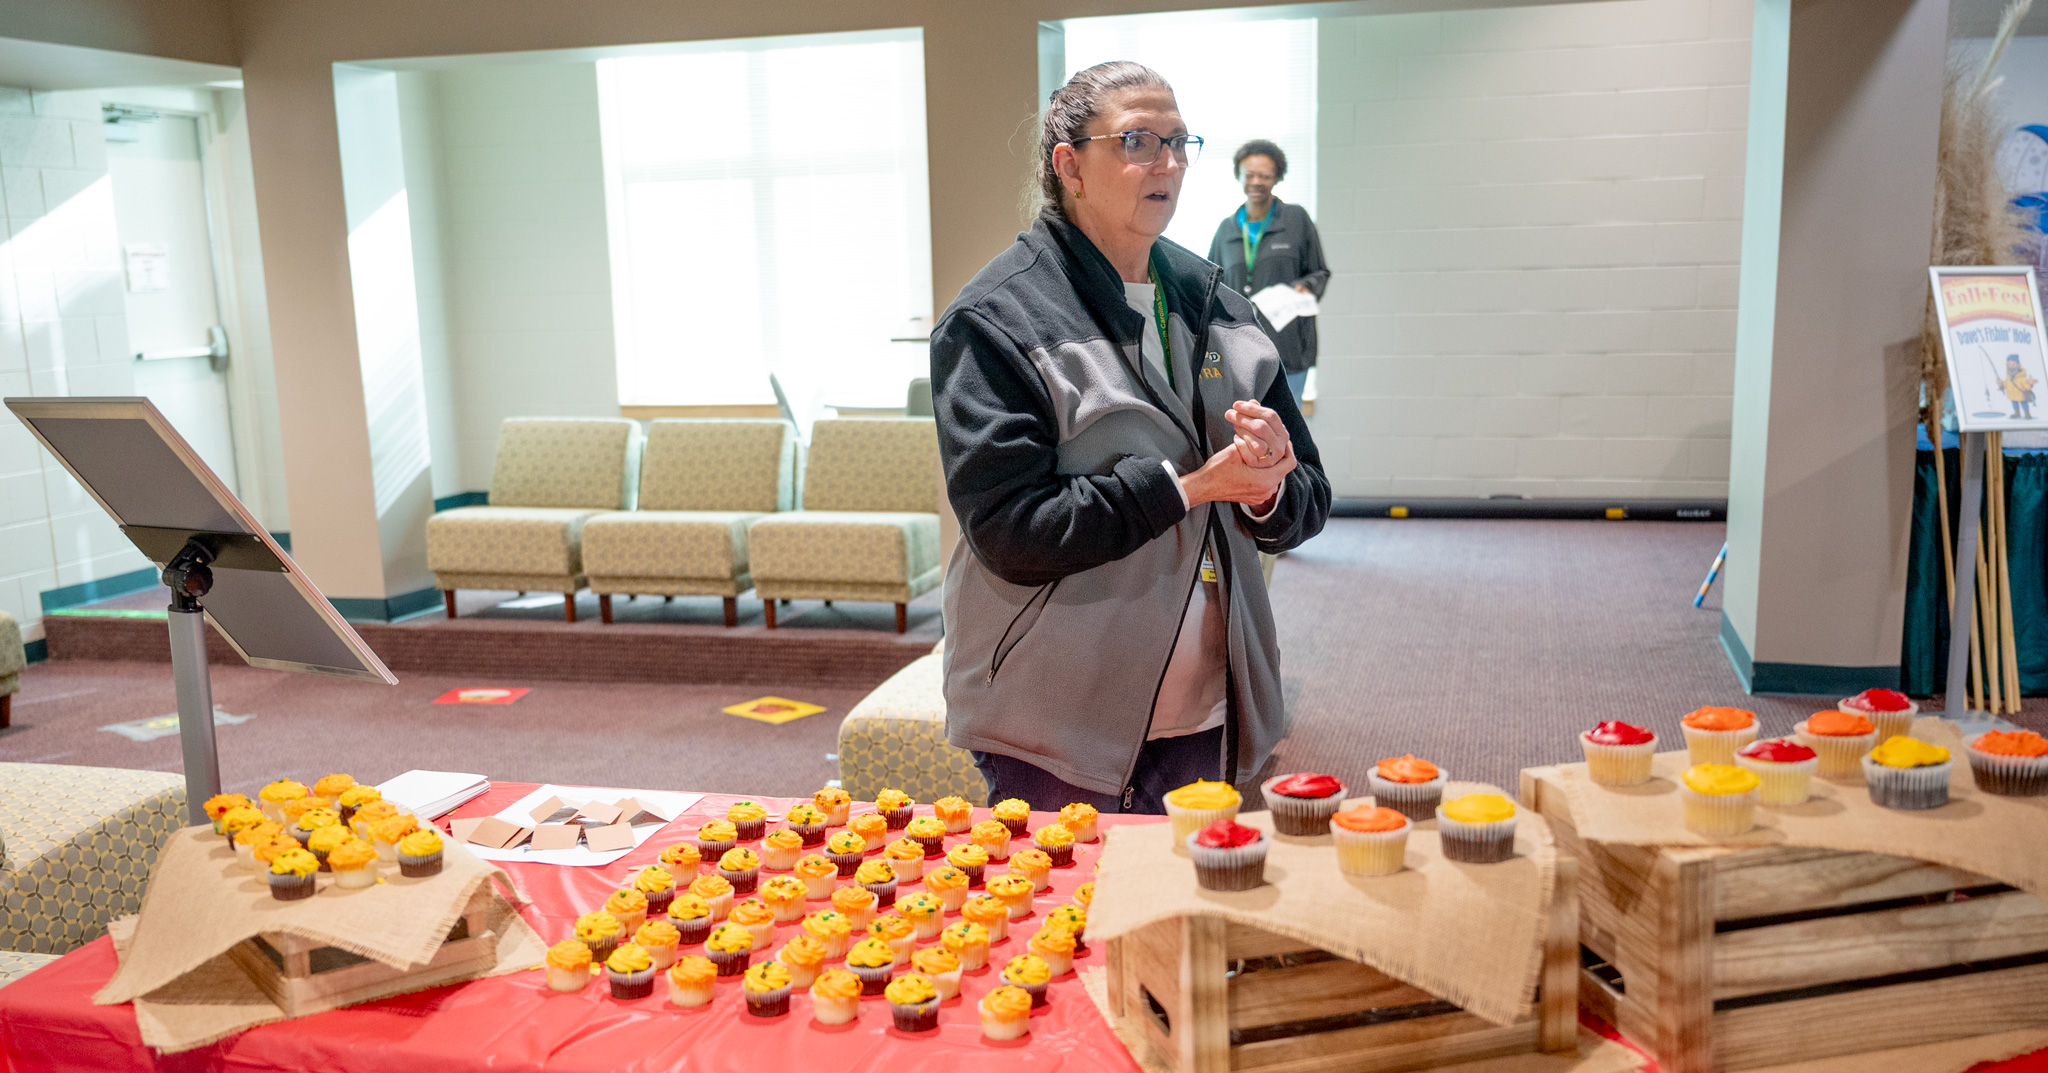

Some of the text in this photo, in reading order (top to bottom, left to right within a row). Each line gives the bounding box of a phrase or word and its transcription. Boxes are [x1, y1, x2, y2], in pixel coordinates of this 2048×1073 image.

[1945, 287, 2028, 306] Fall Fest
[1158, 301, 1166, 329] Carolina
[1957, 327, 2031, 345] Dave's Fishin' Hole
[1199, 367, 1223, 379] RA
